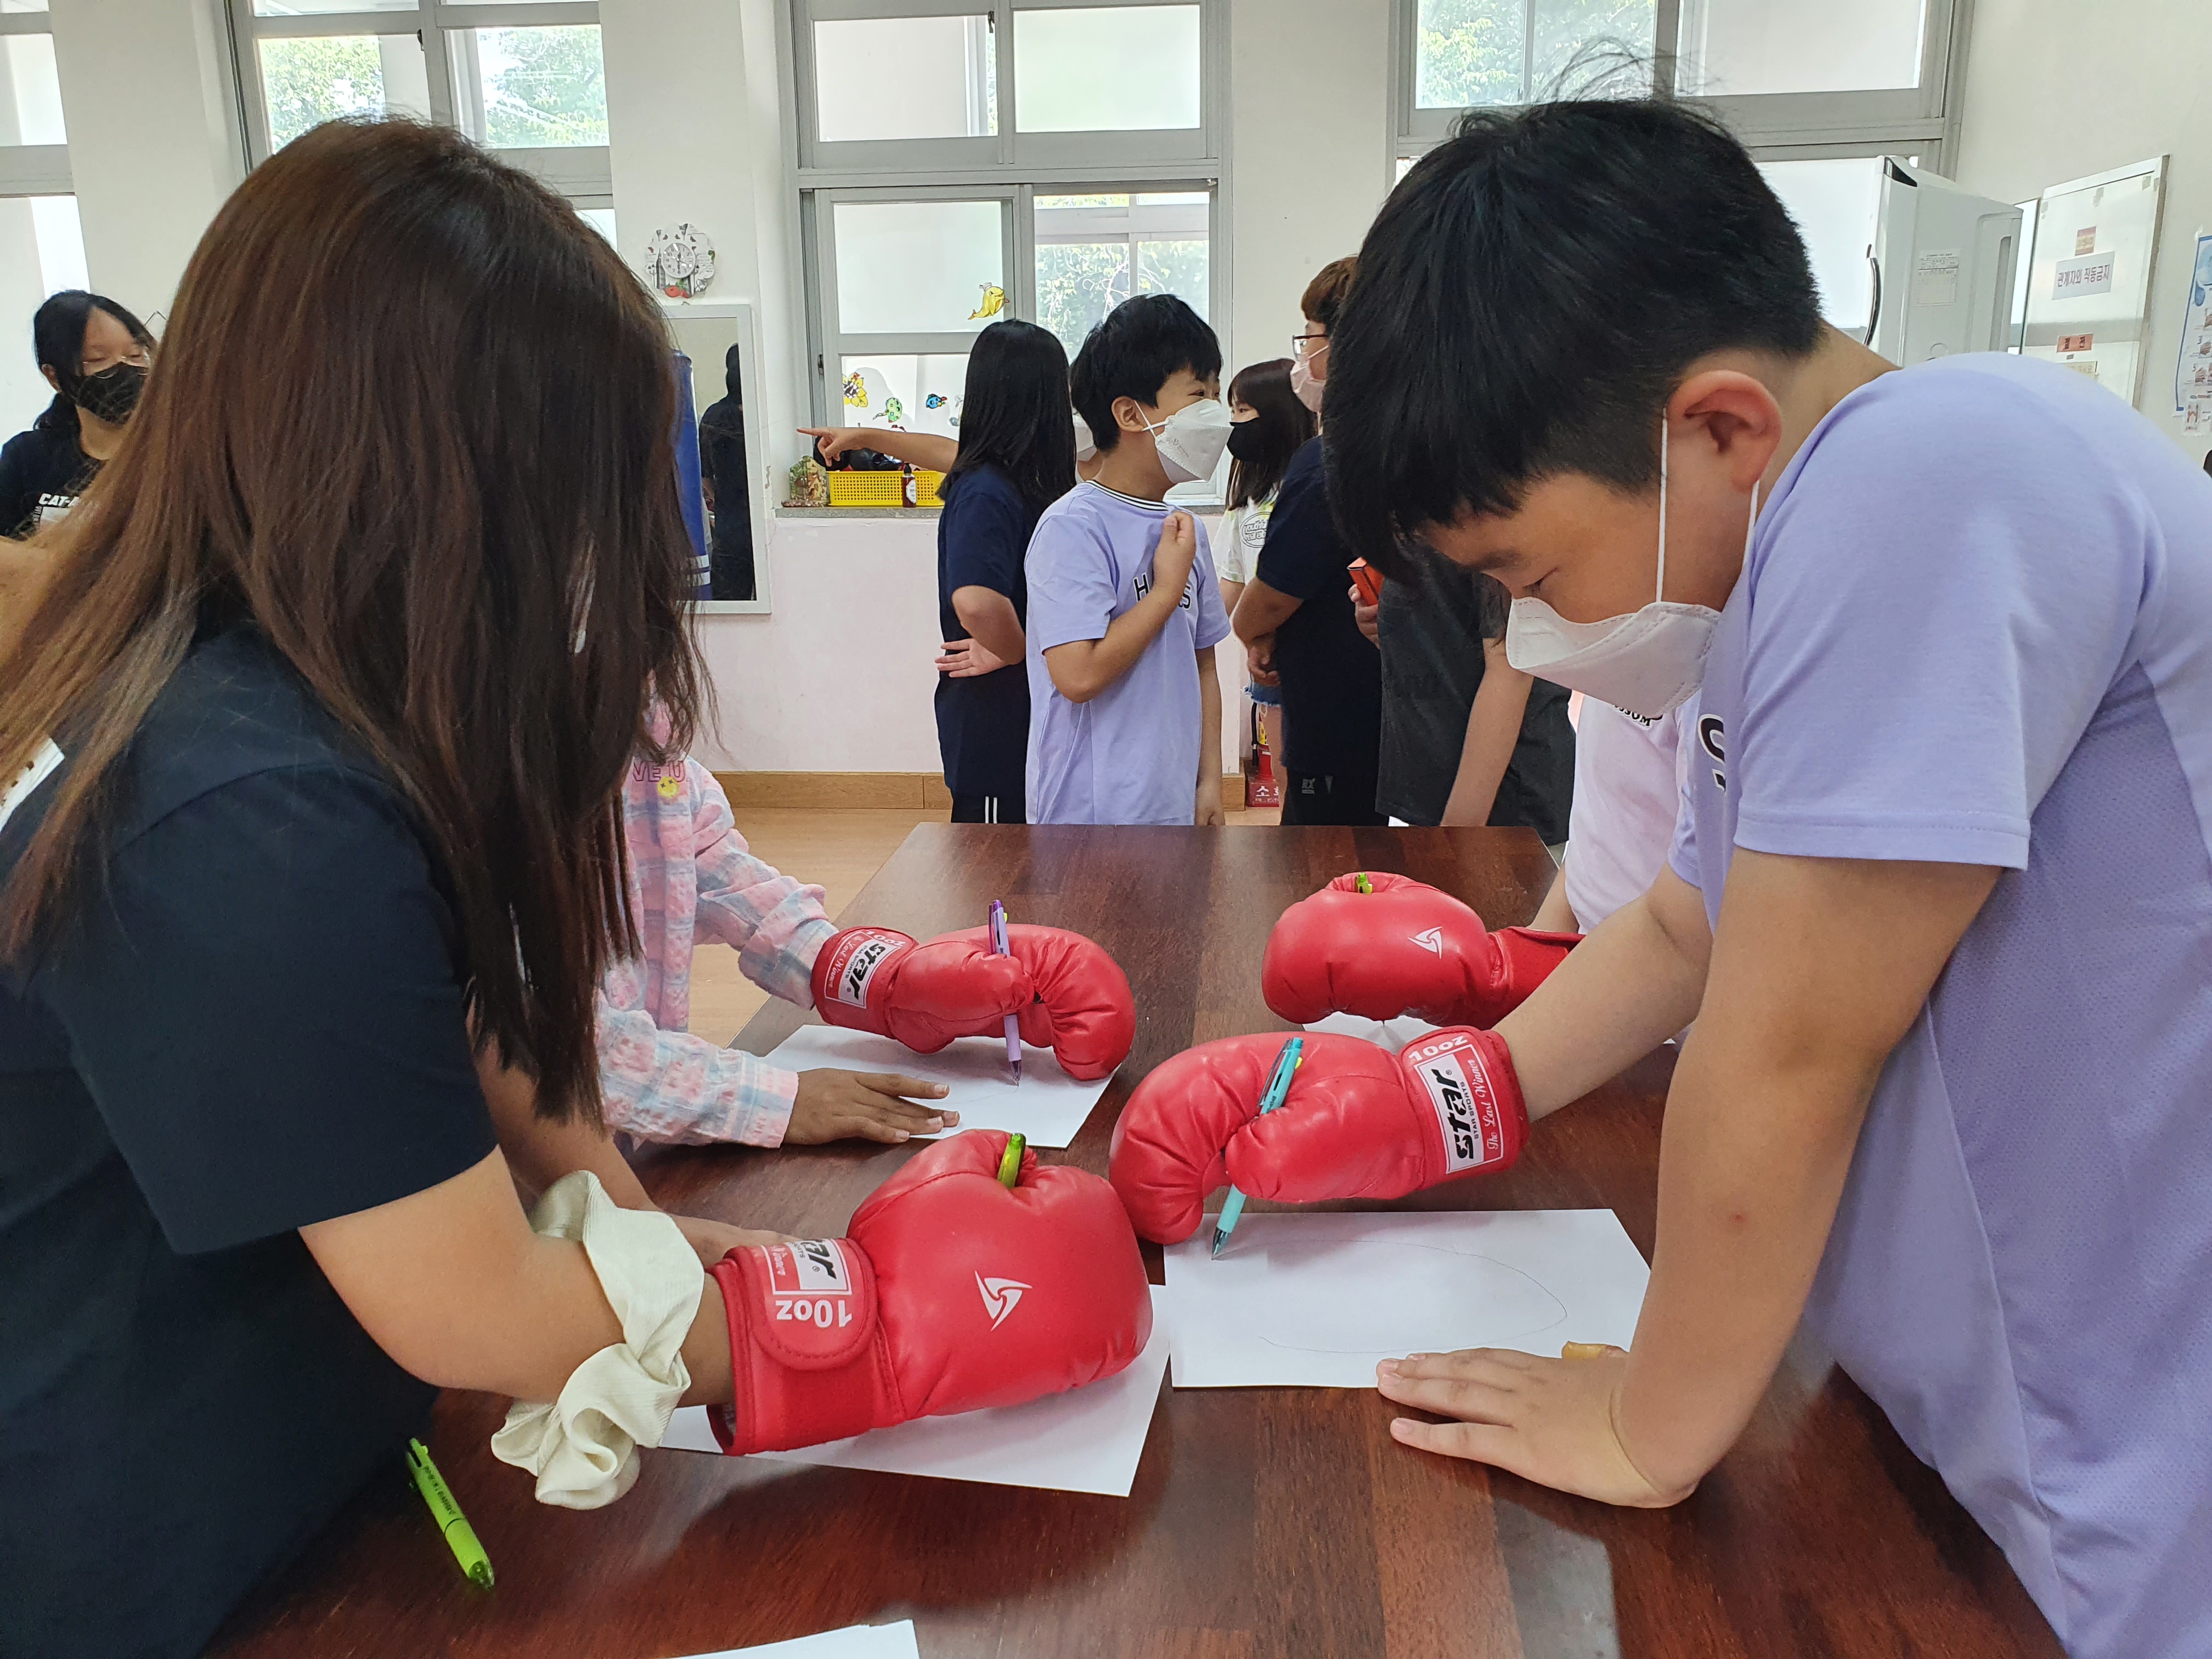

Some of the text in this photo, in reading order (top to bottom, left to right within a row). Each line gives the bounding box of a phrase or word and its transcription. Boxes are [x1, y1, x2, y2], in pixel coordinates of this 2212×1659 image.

[2057, 264, 2111, 287] 관계자외 작동금지
[1459, 1081, 1480, 1139] STAR SPORTS
[1467, 1059, 1500, 1150] The Last Winner
